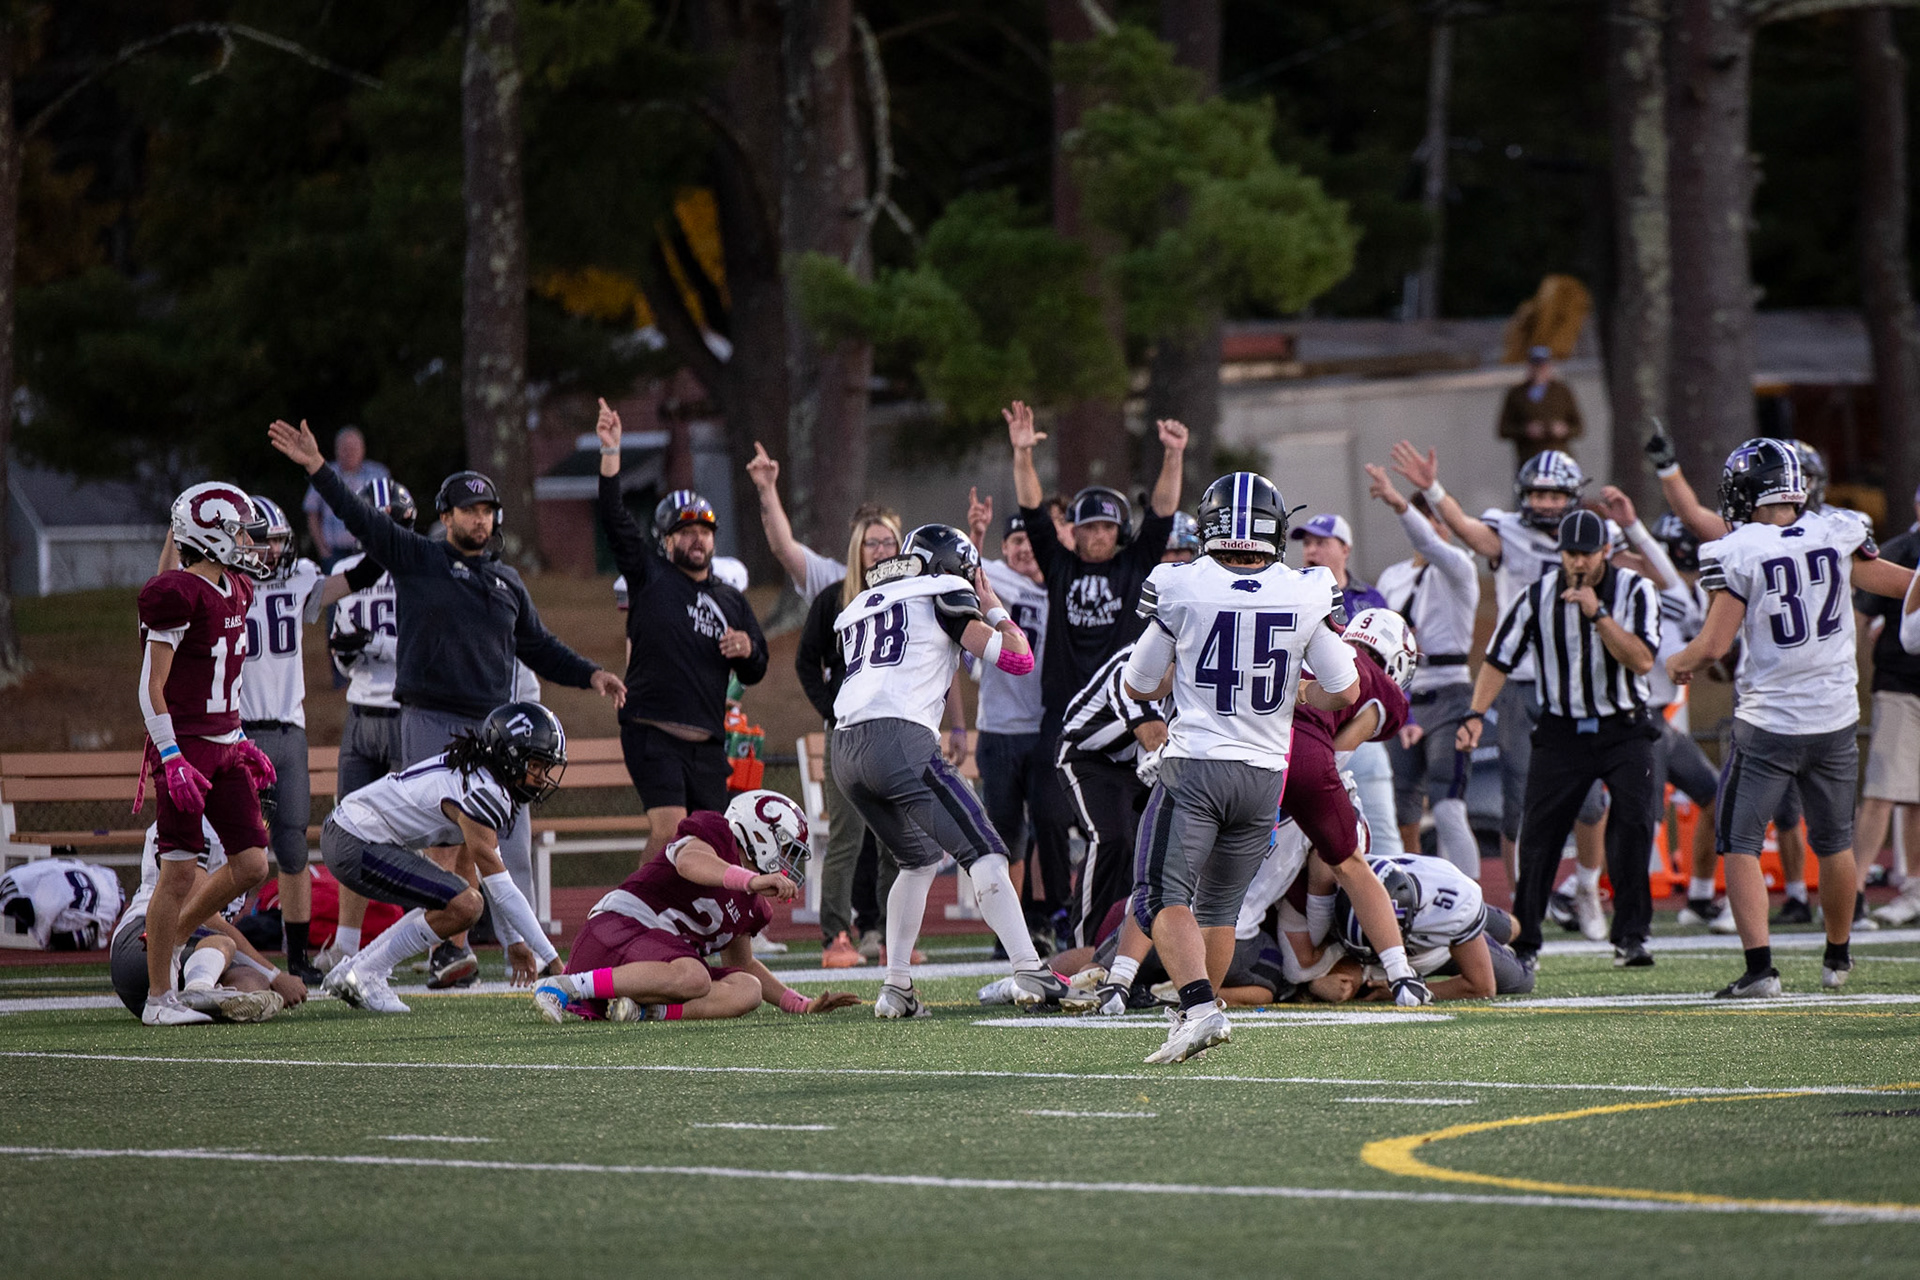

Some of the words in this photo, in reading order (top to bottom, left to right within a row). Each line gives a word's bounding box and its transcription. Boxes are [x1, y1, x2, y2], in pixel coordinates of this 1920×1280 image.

[465, 479, 486, 493] VT
[1220, 540, 1258, 551] Riddell
[1762, 547, 1842, 648] 32
[224, 615, 243, 629] RAMS
[1360, 616, 1373, 630] 9
[843, 601, 909, 685] 28
[1195, 611, 1297, 716] 45
[505, 713, 533, 737] 17
[1432, 888, 1459, 910] 51
